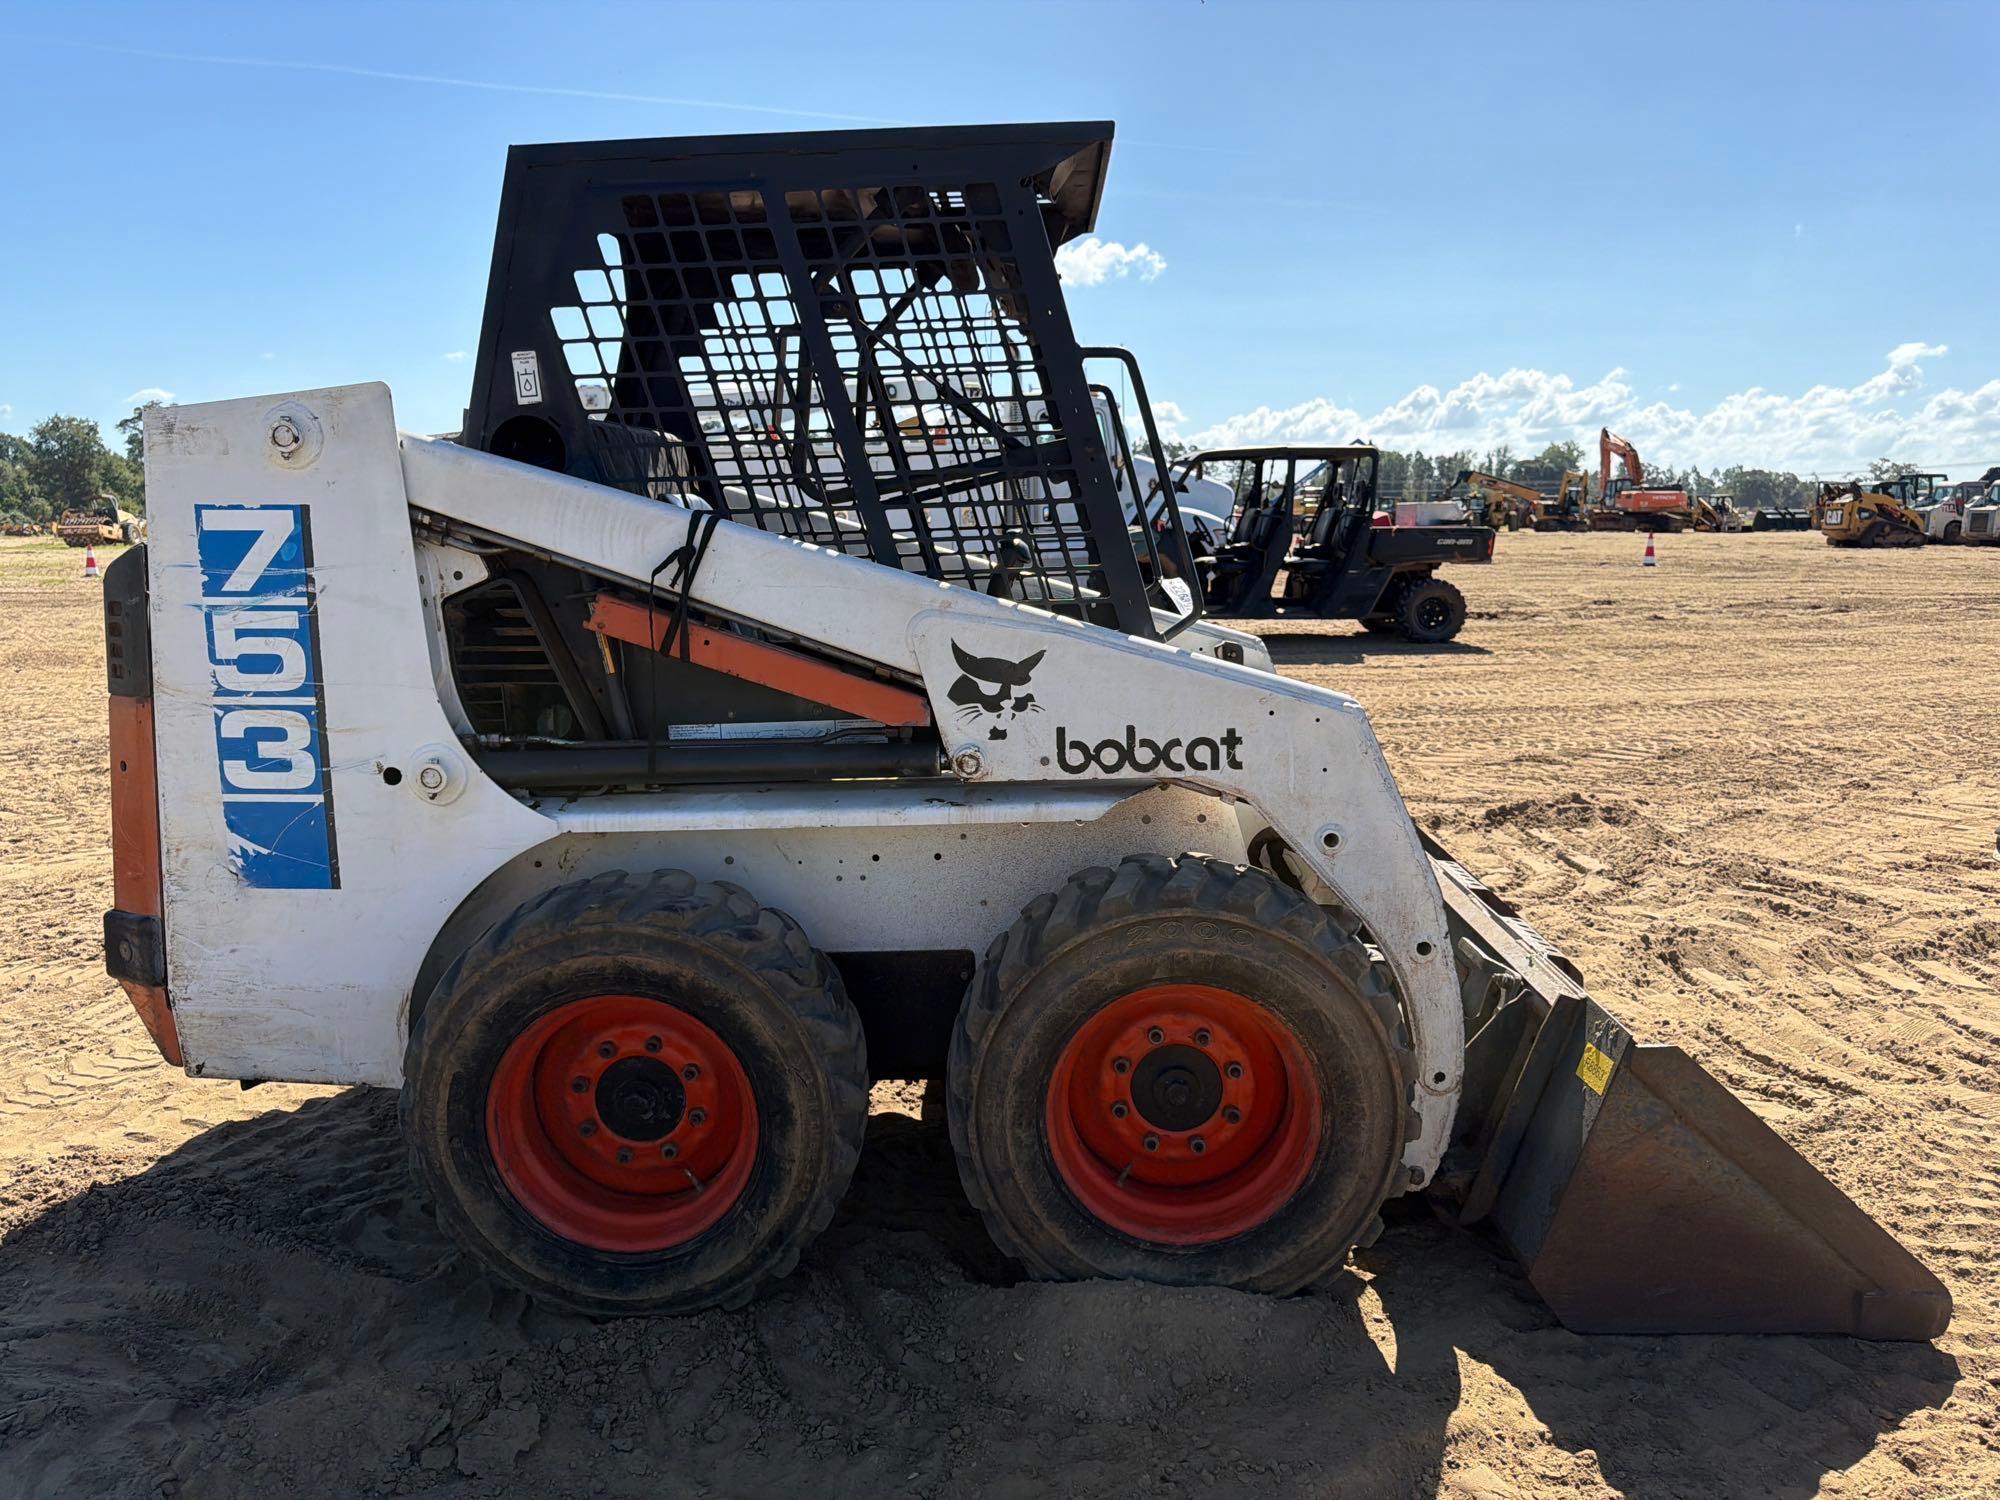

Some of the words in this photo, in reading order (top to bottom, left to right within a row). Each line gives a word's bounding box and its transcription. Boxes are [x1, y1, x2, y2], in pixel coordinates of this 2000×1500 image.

[1826, 510, 1843, 524] CAT
[201, 509, 317, 790] 753
[1056, 724, 1243, 775] bobcat
